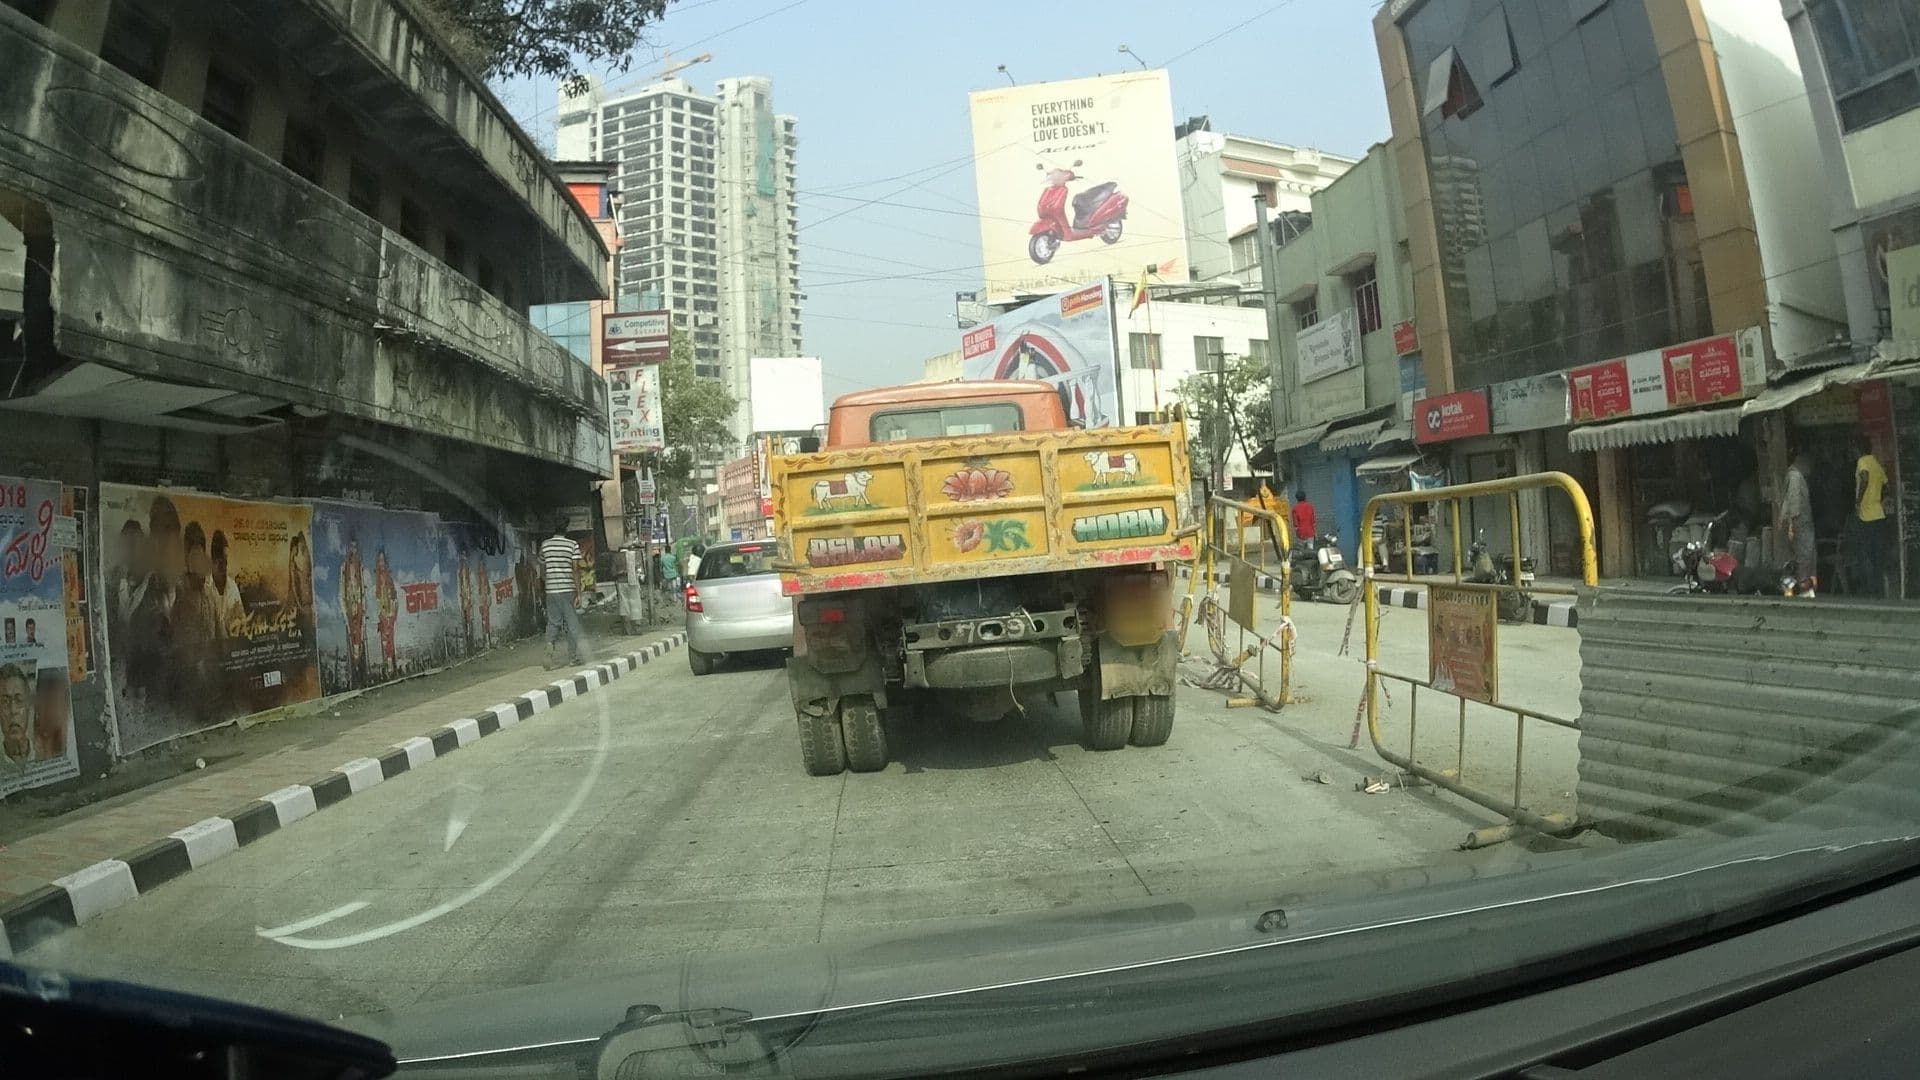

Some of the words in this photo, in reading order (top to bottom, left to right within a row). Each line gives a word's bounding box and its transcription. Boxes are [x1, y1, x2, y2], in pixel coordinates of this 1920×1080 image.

[1031, 97, 1094, 116] EVERYTHING
[1032, 112, 1084, 129] CHANGES,
[1033, 128, 1059, 143] LOVE
[1062, 121, 1110, 139] DOESN'T.
[624, 319, 665, 328] Competitive
[1441, 400, 1463, 417] kotak
[1074, 507, 1167, 541] HORN
